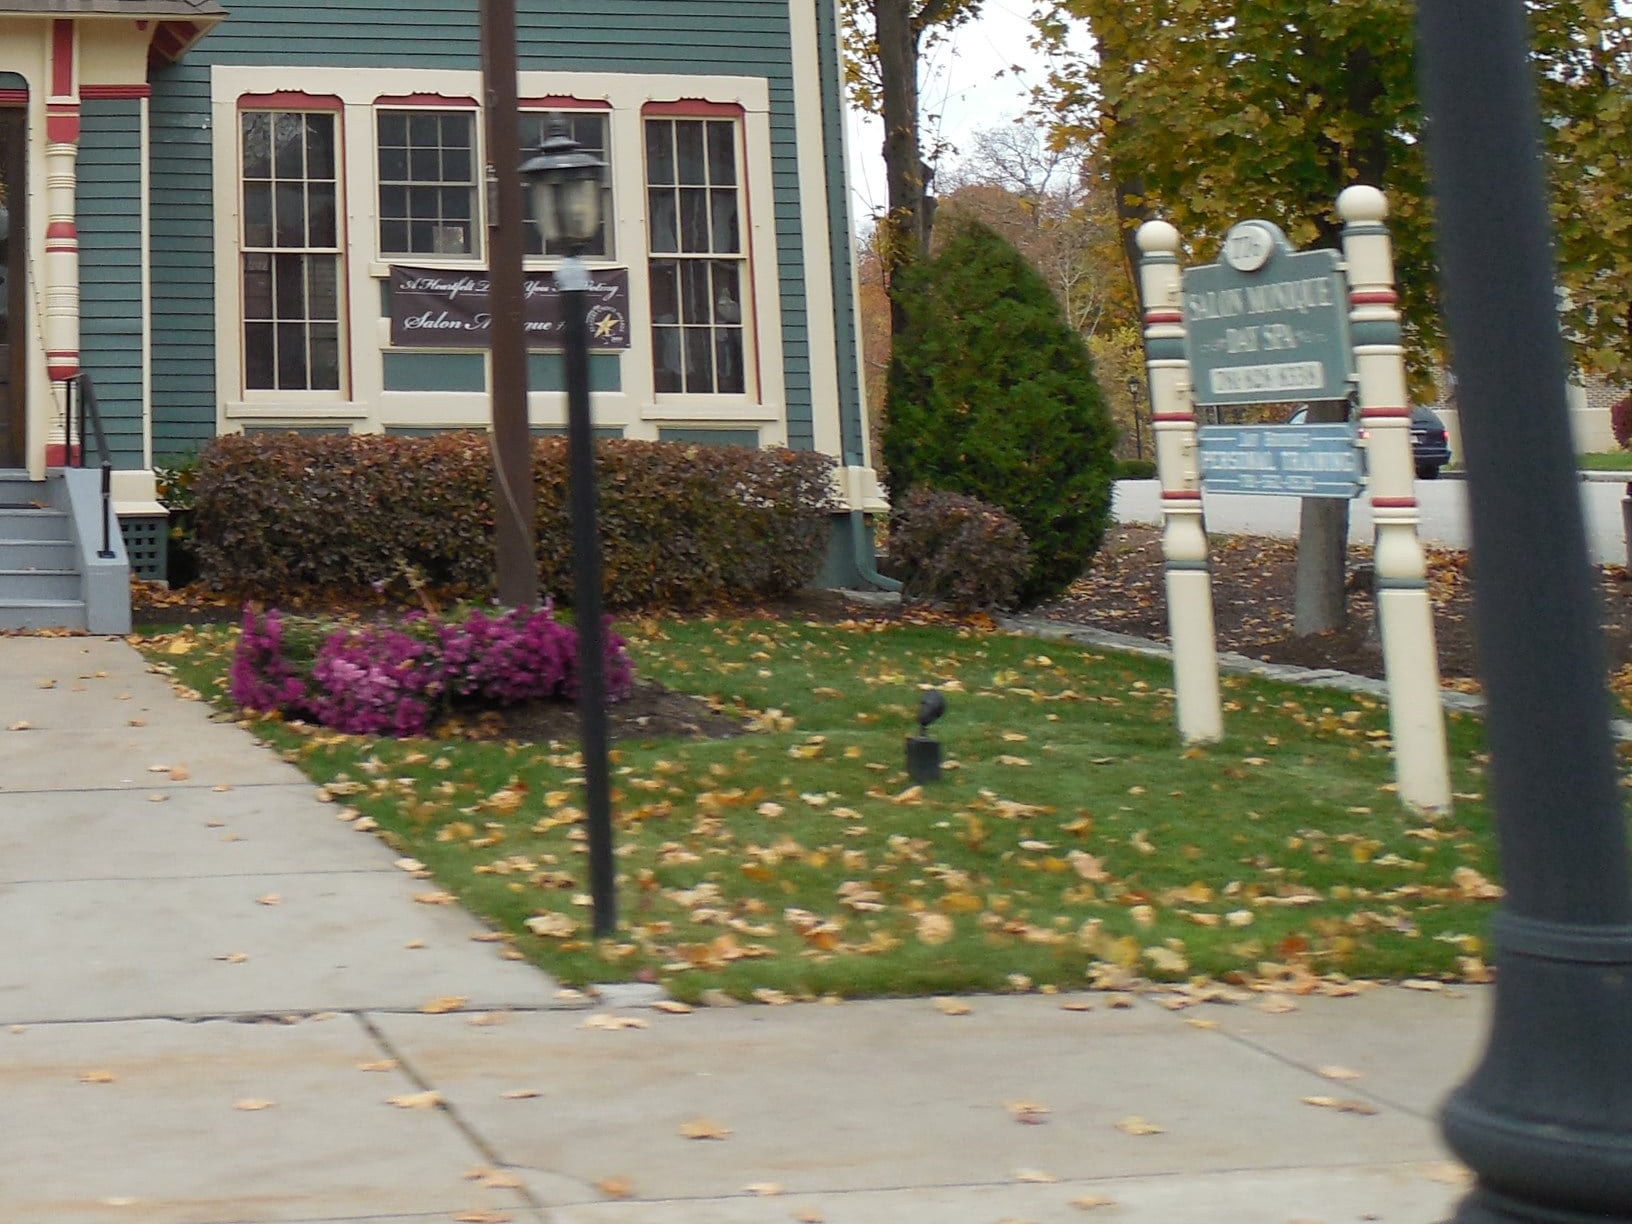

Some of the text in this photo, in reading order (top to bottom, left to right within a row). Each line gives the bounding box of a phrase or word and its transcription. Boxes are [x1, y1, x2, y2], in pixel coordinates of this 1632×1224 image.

[419, 276, 475, 300] Heartfelt
[523, 279, 550, 299] You
[1189, 277, 1333, 321] SALON MONIQUE
[403, 311, 462, 331] Salon
[1262, 323, 1297, 351] SPA
